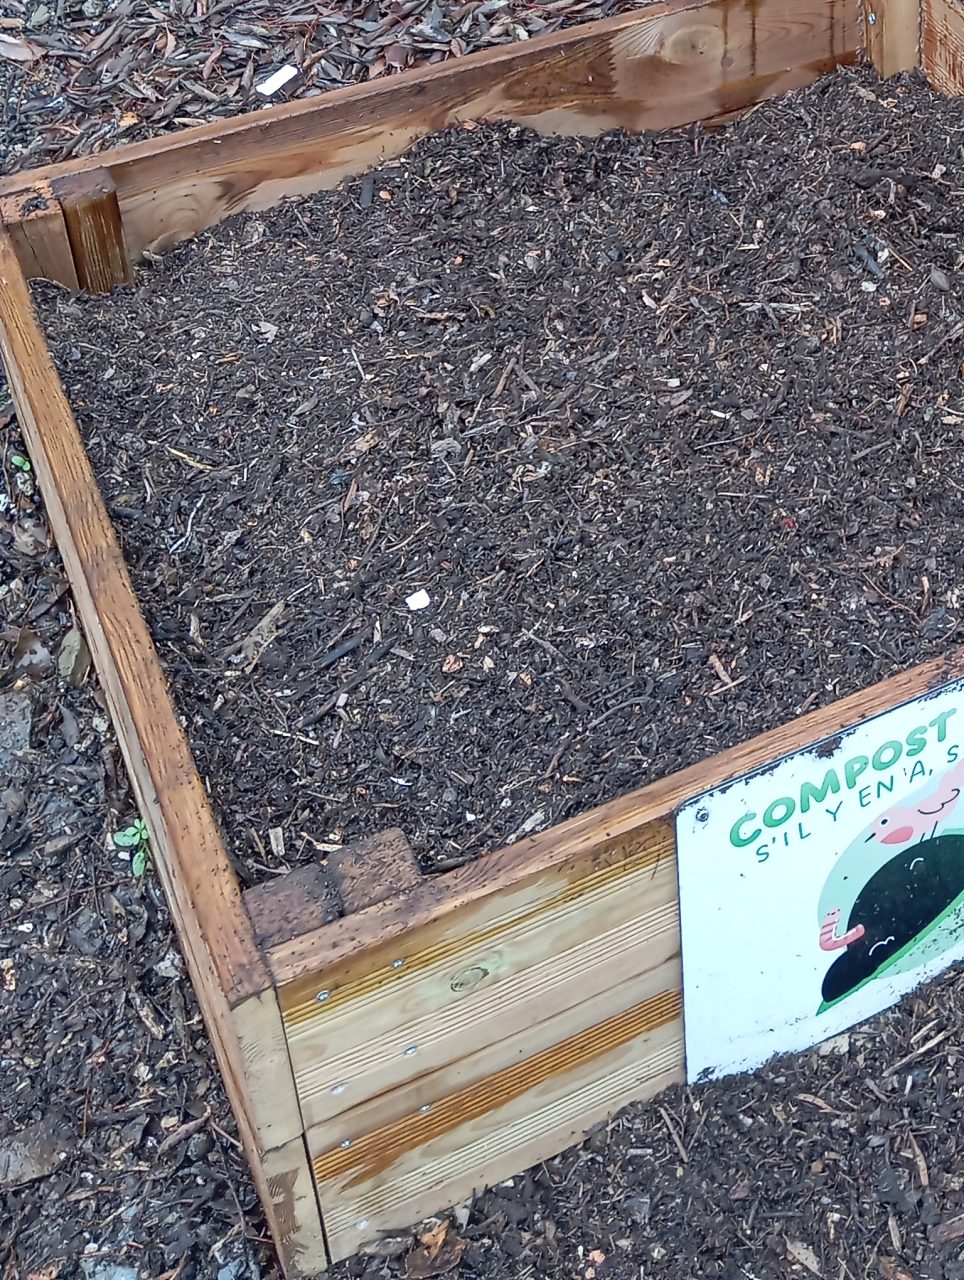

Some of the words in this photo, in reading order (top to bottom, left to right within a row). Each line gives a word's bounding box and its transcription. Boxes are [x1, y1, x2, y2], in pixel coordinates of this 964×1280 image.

[730, 709, 956, 847] COMPOST
[755, 827, 811, 862] S'IL
[826, 806, 843, 822] Y
[859, 780, 894, 807] EN
